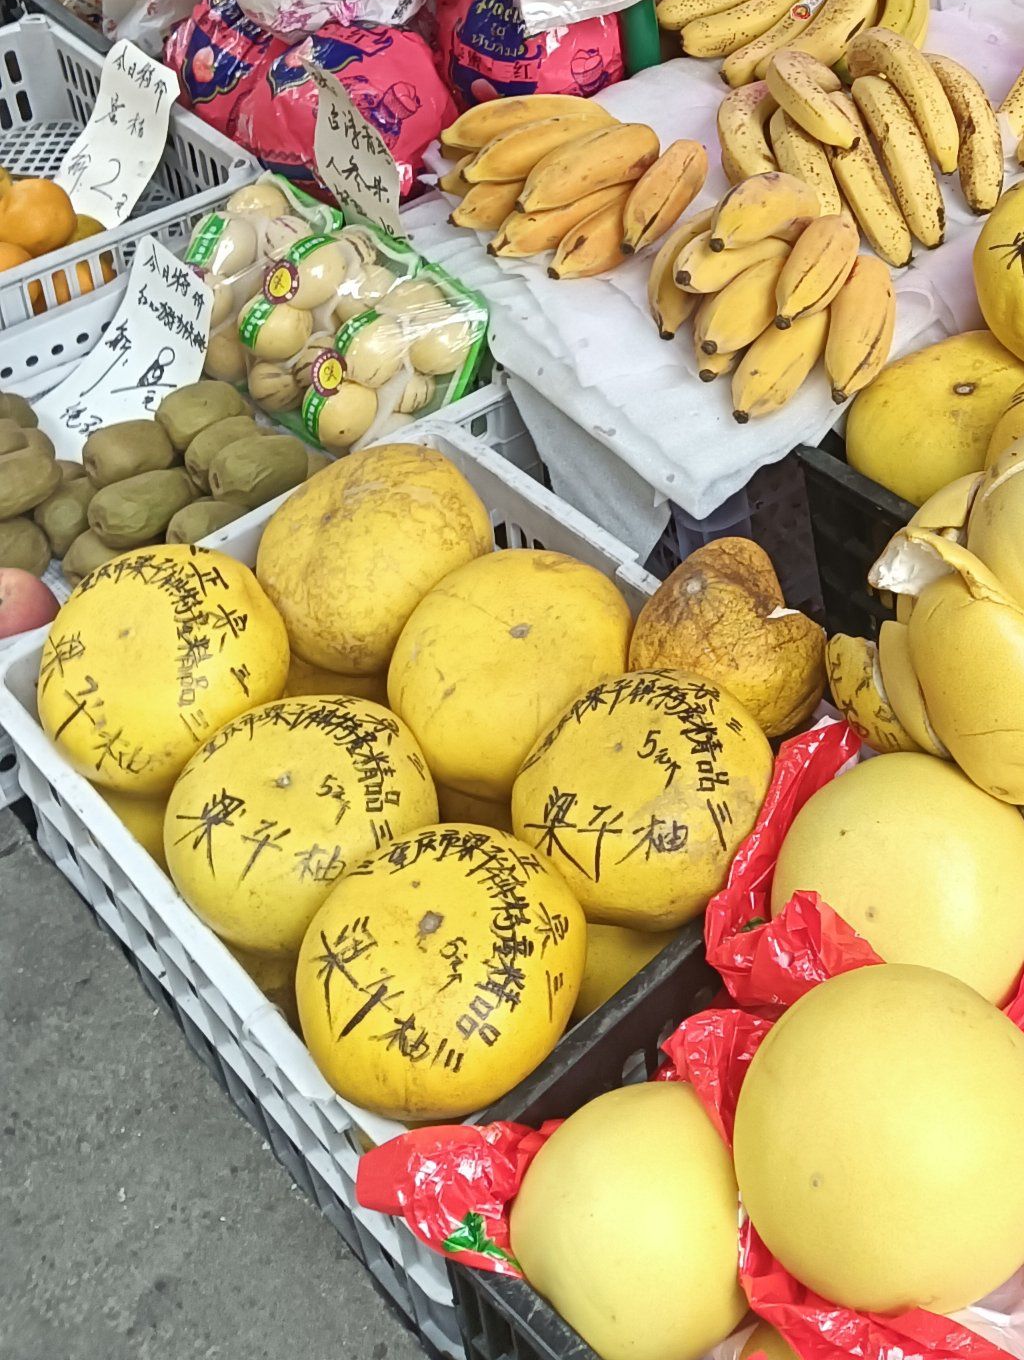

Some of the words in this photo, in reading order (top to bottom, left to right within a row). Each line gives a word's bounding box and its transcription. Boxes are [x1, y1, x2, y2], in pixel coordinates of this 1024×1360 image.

[172, 786, 347, 889] 梁平柚
[523, 785, 689, 883] 梁平柚
[309, 915, 431, 1063] 梁平柚
